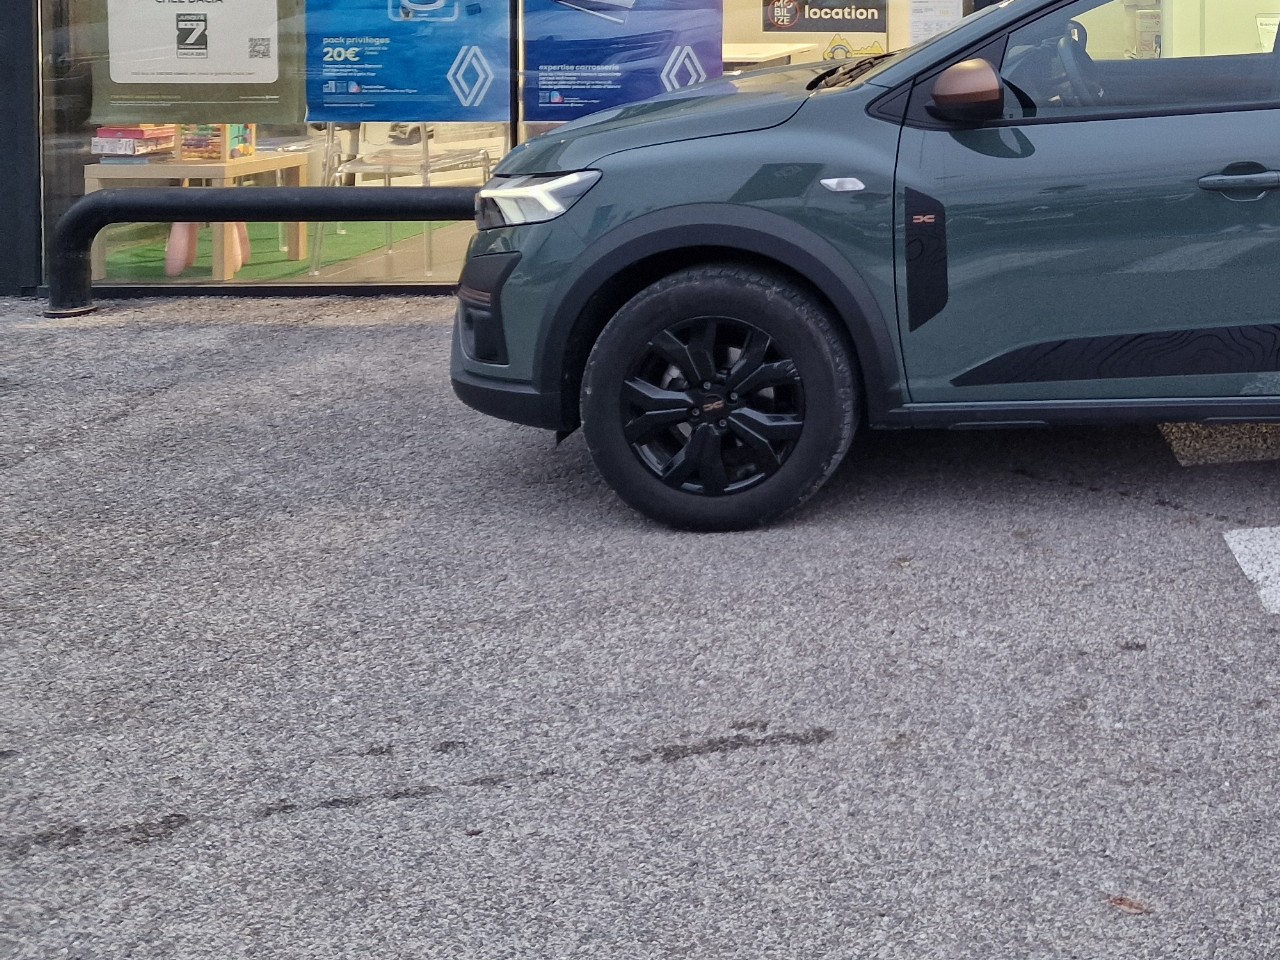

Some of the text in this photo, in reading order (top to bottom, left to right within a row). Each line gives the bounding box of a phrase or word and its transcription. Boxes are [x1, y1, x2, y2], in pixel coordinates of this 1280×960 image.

[804, 4, 879, 20] location
[322, 46, 361, 62] 20€
[538, 64, 575, 72] expertise
